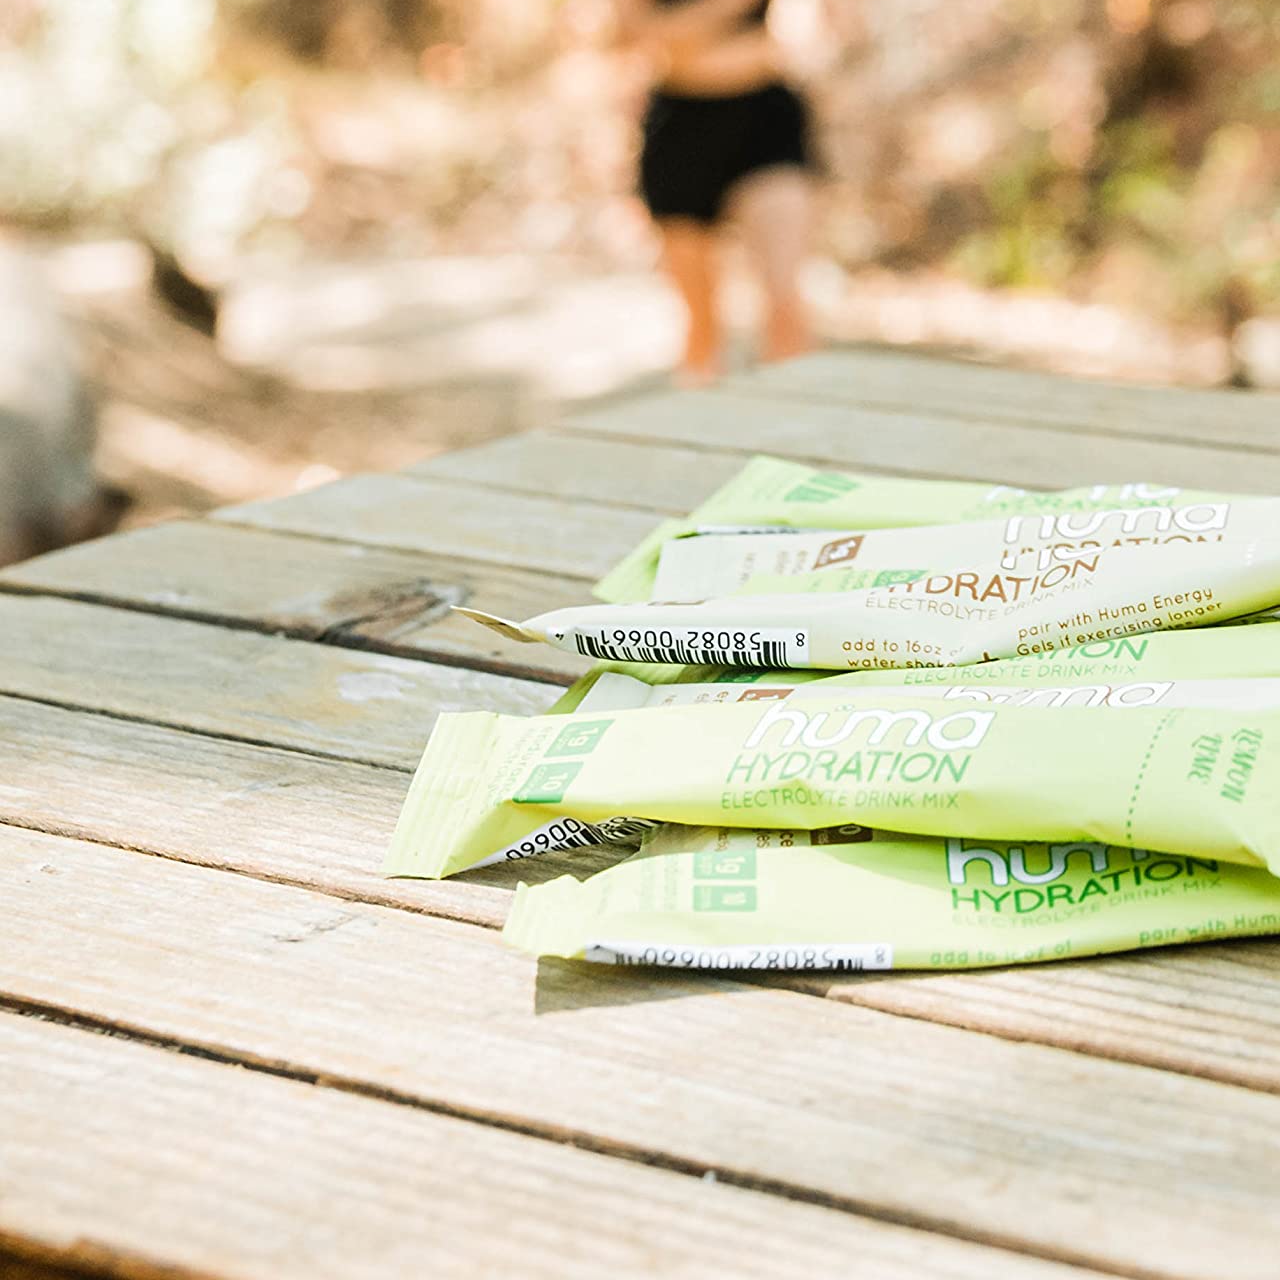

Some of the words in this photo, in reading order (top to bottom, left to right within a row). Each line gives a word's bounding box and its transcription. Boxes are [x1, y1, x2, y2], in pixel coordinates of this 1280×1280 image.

[888, 555, 1100, 604] DRATION
[865, 596, 998, 621] ELECTROLYTE
[1061, 577, 1094, 593] MIX
[1018, 620, 1051, 641] pair
[1057, 613, 1093, 631] with
[1099, 602, 1147, 622] Huma
[1153, 587, 1214, 610] Energy
[600, 629, 674, 649] 00661
[686, 631, 762, 651] 58082
[795, 632, 806, 648] 8
[1016, 639, 1055, 657] Gels
[1060, 634, 1070, 648] if
[1076, 615, 1163, 645] exercising
[1168, 600, 1223, 625] longer
[842, 639, 876, 652] add
[883, 640, 898, 652] to
[905, 640, 942, 656] 16oz
[903, 663, 1031, 686] ELECTROLYTE
[1036, 663, 1095, 679] DRINK
[1101, 662, 1138, 678] MIX
[726, 750, 972, 784] HYDRATION
[1187, 733, 1224, 785] LIME
[1219, 727, 1264, 804] LEMON
[721, 788, 849, 809] ELECTROLYTE
[855, 790, 915, 808] DRINK
[922, 792, 960, 809] MIX
[951, 859, 1219, 915] HYDRATION
[1107, 884, 1175, 908] DRINK
[1182, 876, 1224, 894] MIX
[1138, 927, 1177, 946] pair
[1186, 920, 1227, 935] with
